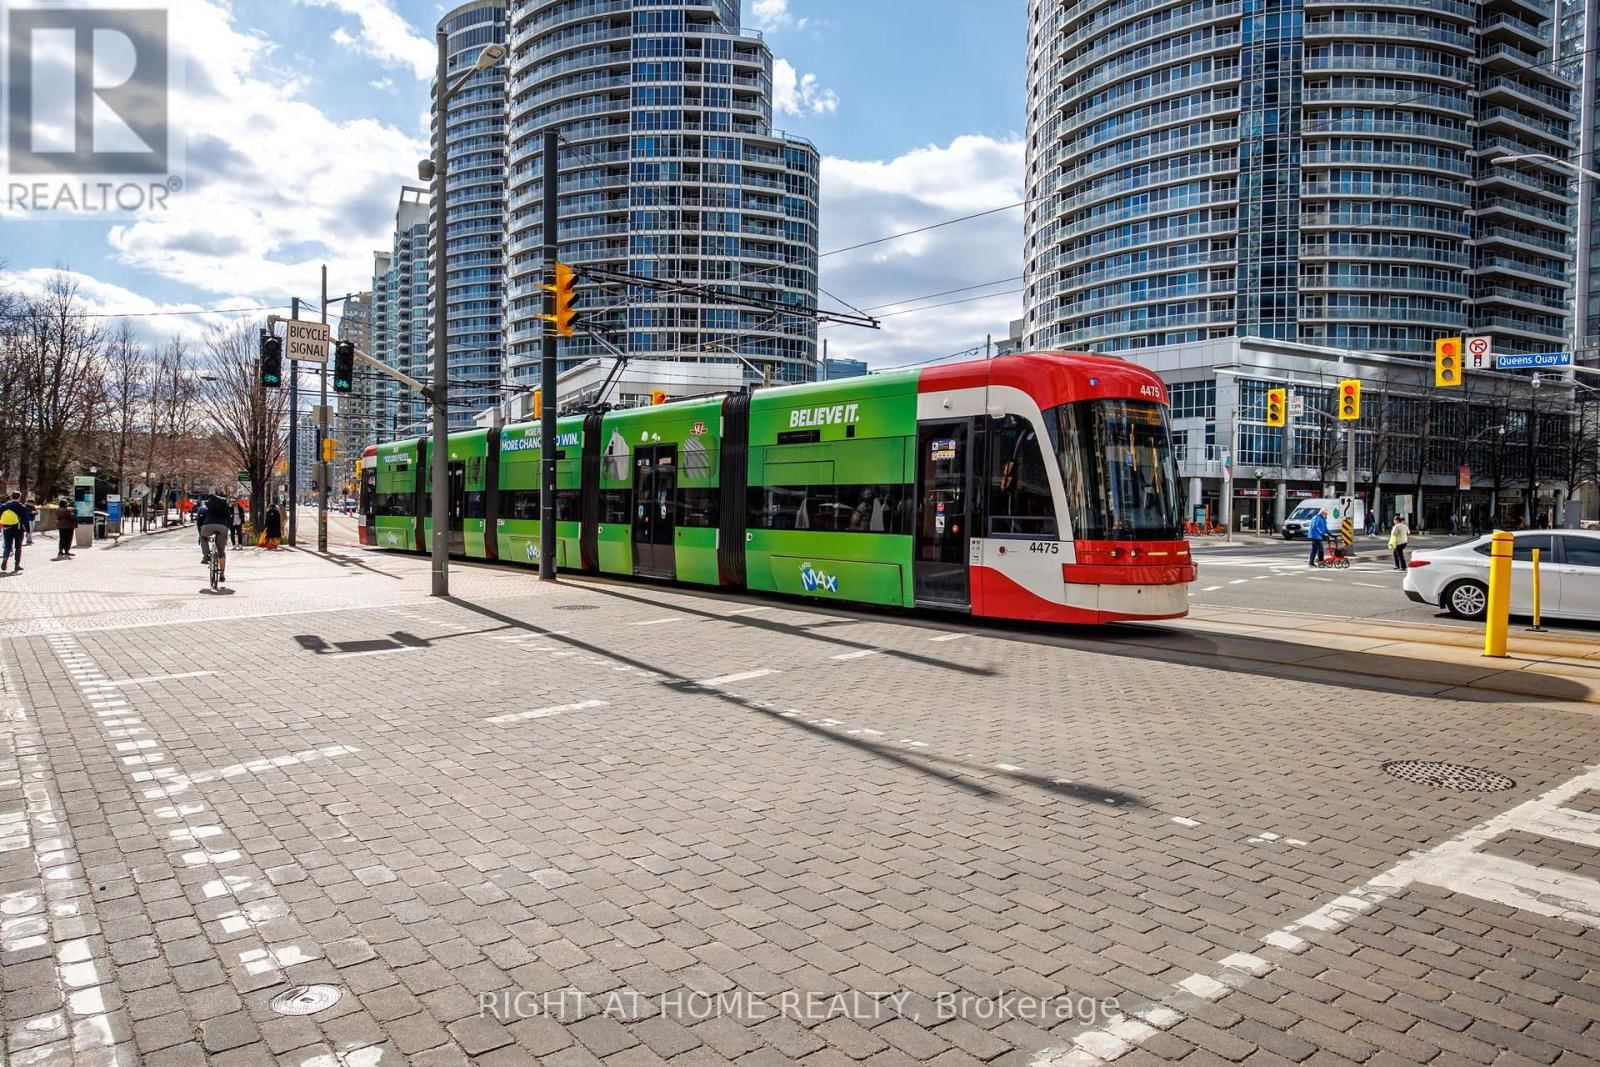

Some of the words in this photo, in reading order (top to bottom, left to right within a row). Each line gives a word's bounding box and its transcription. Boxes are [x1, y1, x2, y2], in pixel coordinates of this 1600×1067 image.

[290, 326, 327, 341] BICYCLE
[290, 341, 325, 356] SIGNAL
[1499, 356, 1533, 366] Queens
[1535, 355, 1558, 365] Quay
[1560, 354, 1569, 362] W
[1140, 385, 1160, 398] 4475
[789, 405, 844, 427] BELIEVE
[843, 403, 860, 423] IT.
[501, 439, 519, 451] MORE
[518, 437, 543, 450] CHANC
[561, 433, 579, 445] WIN.
[1029, 542, 1059, 554] 4475
[802, 568, 836, 592] MAX
